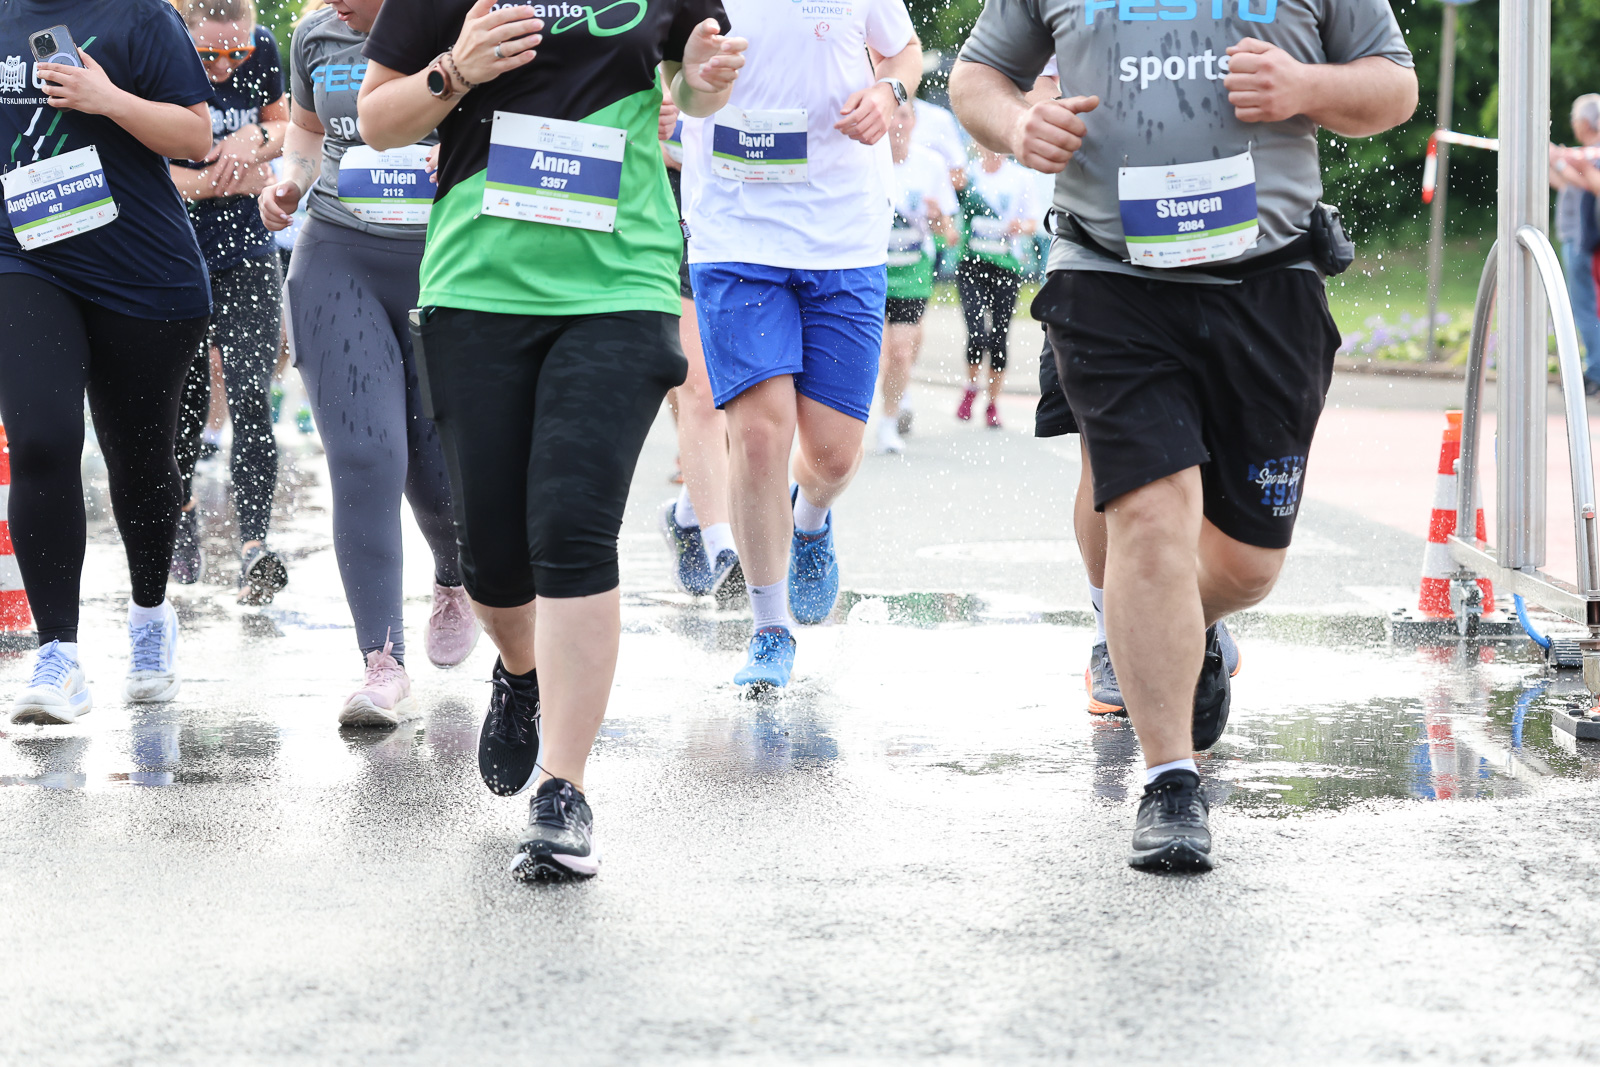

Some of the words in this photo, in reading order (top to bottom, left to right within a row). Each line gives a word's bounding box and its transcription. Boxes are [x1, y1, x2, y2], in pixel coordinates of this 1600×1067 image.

[489, 1, 584, 18] nanto
[738, 131, 775, 148] David
[745, 150, 764, 158] 1441
[530, 151, 581, 175] Anna
[370, 169, 417, 185] Vivien
[540, 176, 568, 189] 3357
[7, 189, 57, 214] Angélica
[57, 173, 104, 197] Israely
[383, 188, 404, 197] 2112
[48, 202, 63, 213] 467
[1156, 196, 1222, 218] Steven
[1177, 219, 1205, 232] 2084
[1272, 503, 1295, 517] TEAM
